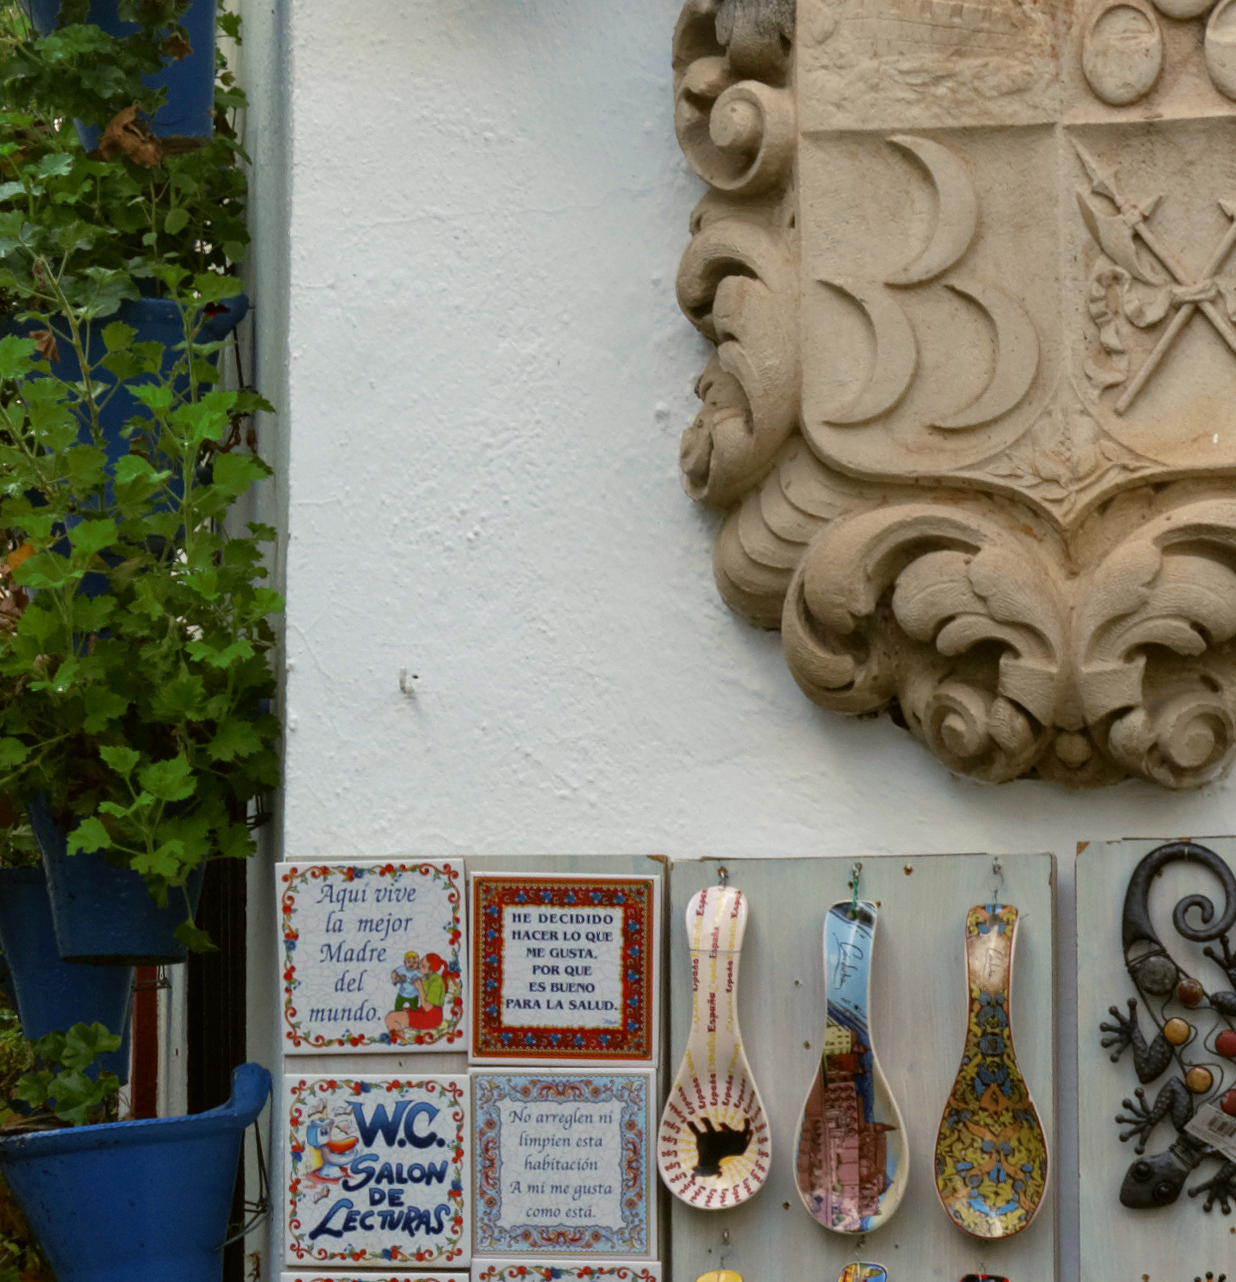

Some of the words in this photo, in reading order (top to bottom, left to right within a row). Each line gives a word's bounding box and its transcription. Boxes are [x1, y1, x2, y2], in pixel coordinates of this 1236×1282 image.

[316, 883, 369, 911] Aquí
[375, 883, 416, 902] vive
[326, 911, 343, 933] la
[358, 913, 412, 941] mejor
[512, 914, 531, 923] HE
[539, 914, 613, 924] DECIDIDO
[512, 931, 558, 941] HACER
[563, 931, 581, 941] LO
[586, 932, 613, 942] QUE
[320, 940, 386, 963] Madre
[527, 948, 545, 958] ME
[550, 948, 597, 959] GUSTA.
[532, 965, 560, 975] POR
[565, 966, 592, 976] QUE
[335, 970, 367, 992] del
[529, 982, 545, 992] ES
[551, 983, 595, 993] BUENO
[309, 1000, 381, 1022] mundo.
[506, 999, 541, 1009] PARA
[547, 1000, 563, 1009] LA
[569, 1000, 618, 1010] SALUD.
[345, 1100, 445, 1149] W.C.
[509, 1107, 531, 1123] No
[536, 1108, 593, 1130] arreglen
[599, 1111, 613, 1123] ni
[519, 1131, 571, 1153] limpien
[576, 1137, 602, 1147] esta
[342, 1153, 448, 1191] SALON
[525, 1154, 598, 1170] habitación
[369, 1188, 404, 1207] DE
[510, 1181, 521, 1194] A
[551, 1184, 570, 1194] me
[572, 1184, 612, 1200] gusta
[309, 1198, 451, 1240] LECTURAS
[526, 1207, 560, 1217] como
[566, 1205, 595, 1218] está.
